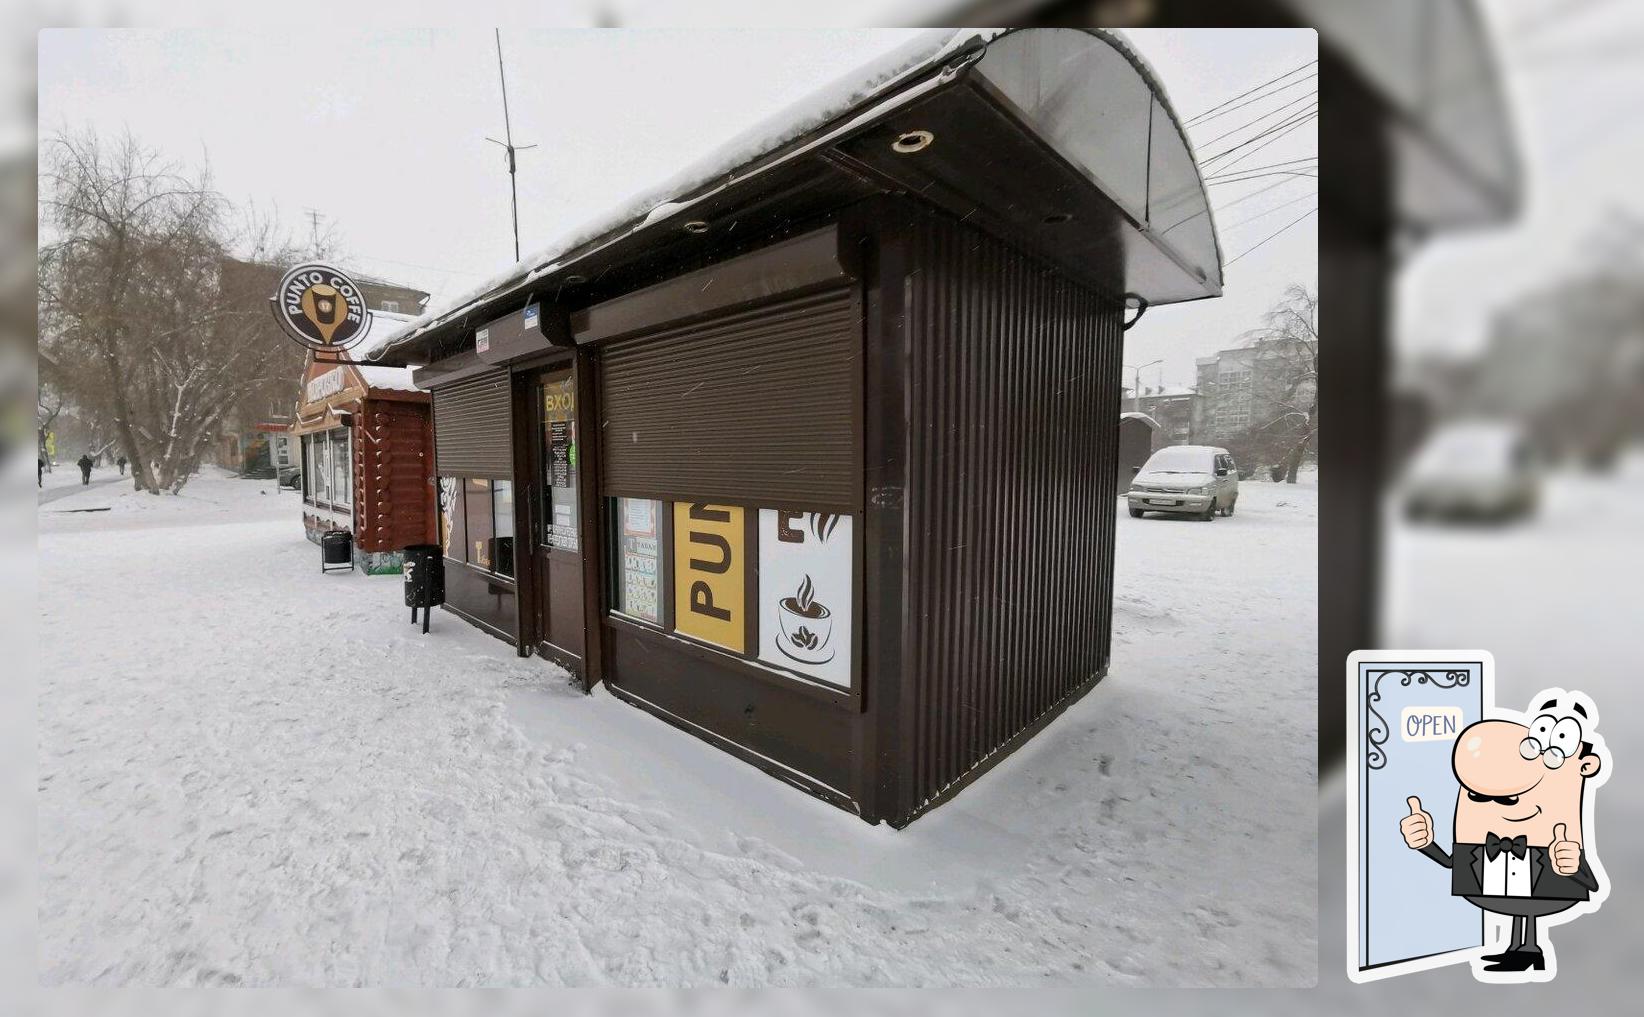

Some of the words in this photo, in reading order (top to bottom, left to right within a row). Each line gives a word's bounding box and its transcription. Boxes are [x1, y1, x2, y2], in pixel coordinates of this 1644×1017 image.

[286, 272, 323, 315] PUNTO
[330, 277, 361, 324] COFFE
[546, 391, 574, 411] ВХО
